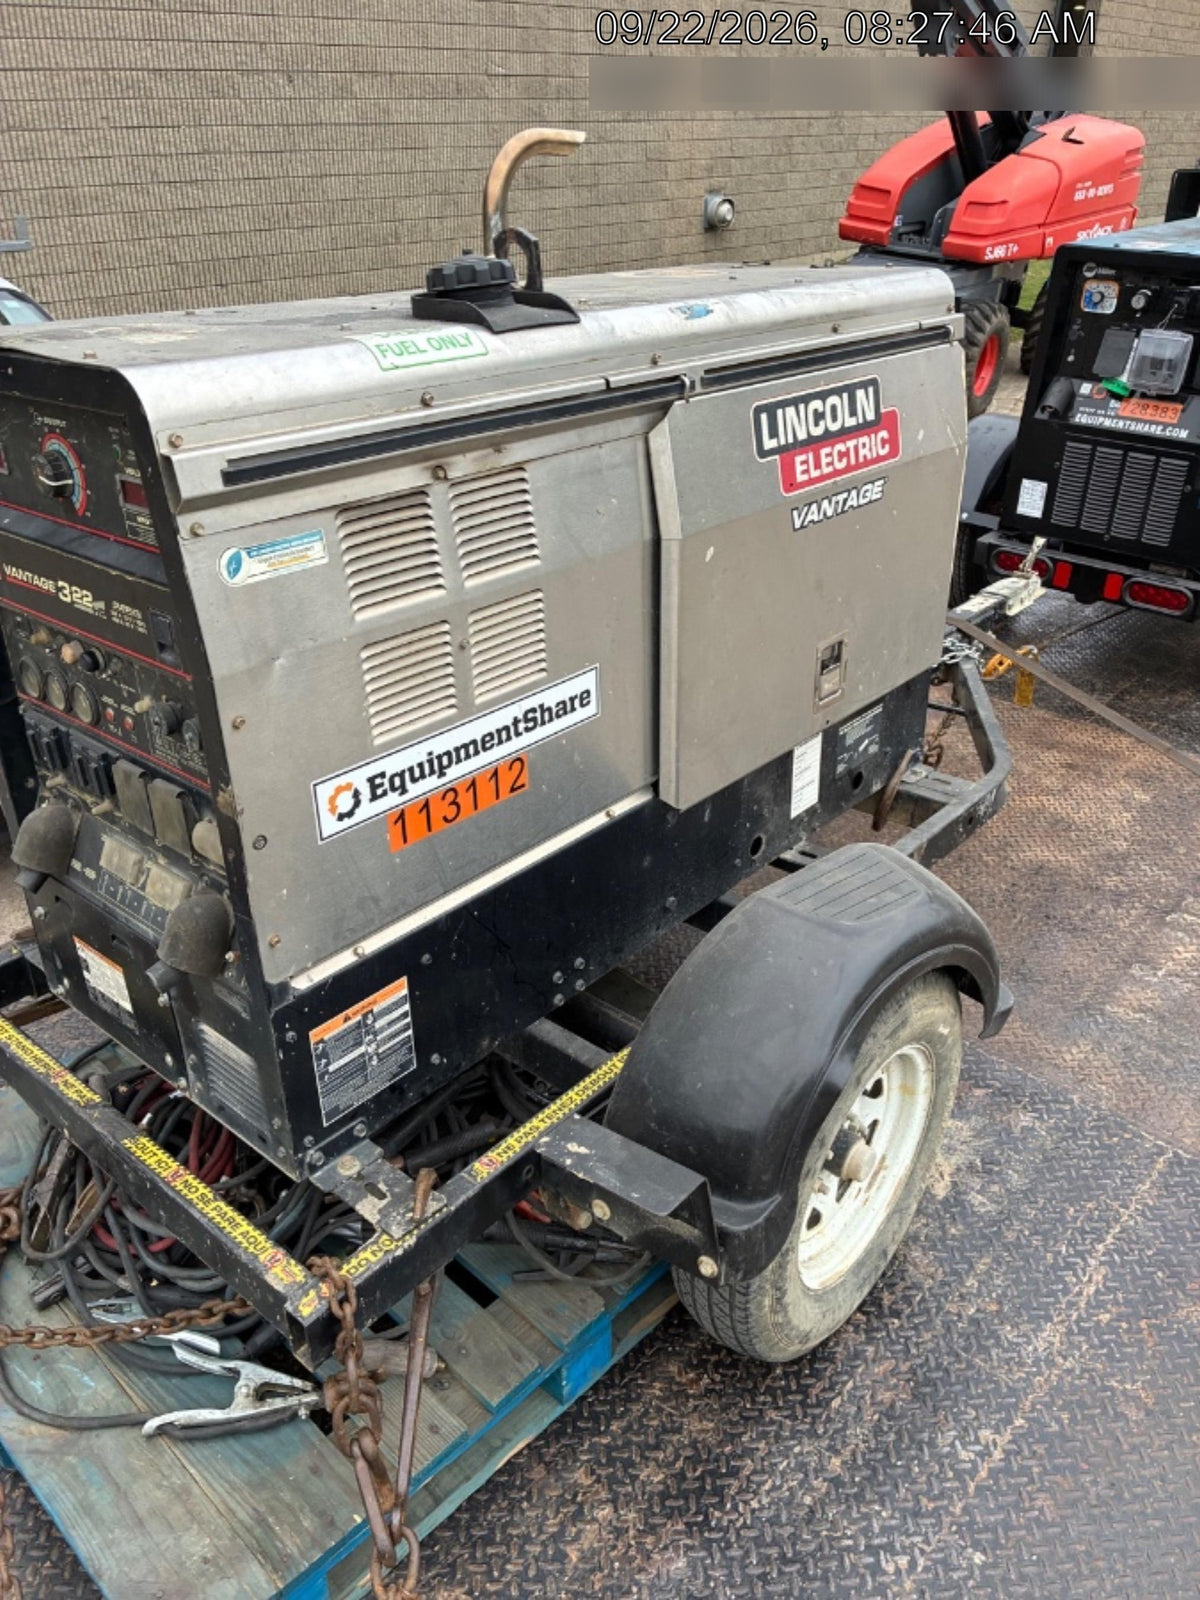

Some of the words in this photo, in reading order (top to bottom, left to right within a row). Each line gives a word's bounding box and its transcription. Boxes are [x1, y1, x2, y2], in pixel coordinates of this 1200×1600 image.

[375, 339, 428, 359] FUEL
[427, 332, 473, 352] ONLY
[760, 385, 876, 451] LINCOLN
[1075, 412, 1190, 439] EQUIPMENTSHARE.COM
[794, 429, 890, 483] ELECTRIC
[791, 477, 886, 531] VANTAGE
[3, 562, 57, 593] VANTAGE
[57, 580, 94, 606] 322
[366, 688, 592, 803] EquipmentShare
[393, 756, 526, 845] 113112
[180, 1179, 200, 1195] NO
[196, 1192, 214, 1208] SE
[210, 1204, 242, 1233] PARE
